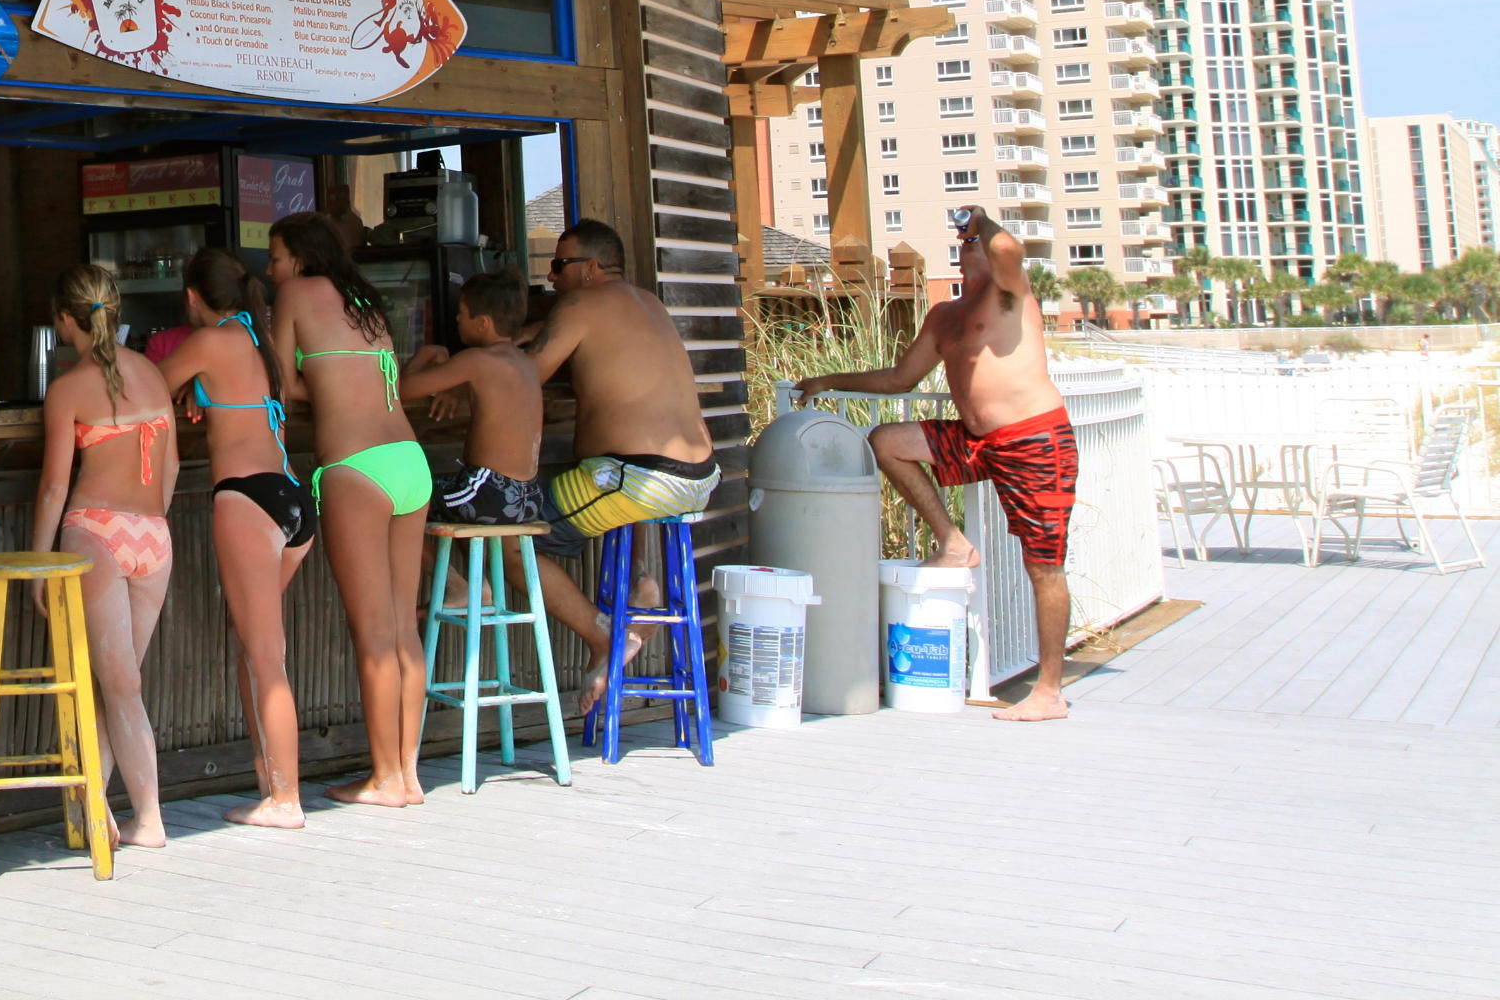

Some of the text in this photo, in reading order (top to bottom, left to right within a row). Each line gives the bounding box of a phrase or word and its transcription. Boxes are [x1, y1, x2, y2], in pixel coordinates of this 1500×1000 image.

[211, 0, 230, 9] Black
[232, 2, 254, 12] Spiced
[293, 6, 348, 19] Malibu Pineapple
[189, 10, 218, 19] Coconut
[240, 14, 272, 25] Pineapple
[200, 24, 212, 32] and
[214, 25, 239, 35] Orange
[293, 19, 305, 27] and
[306, 20, 329, 30] Mango
[203, 36, 222, 46] Touch
[234, 39, 269, 49] Grenadine
[294, 31, 309, 40] Blue
[338, 36, 350, 44] and
[299, 44, 348, 56] Pineapple Juice
[236, 53, 280, 68] PELICAN
[280, 56, 313, 70] BEACH
[257, 69, 295, 82] RESORT
[275, 164, 307, 192] Grab
[88, 189, 216, 212] EXPRESS
